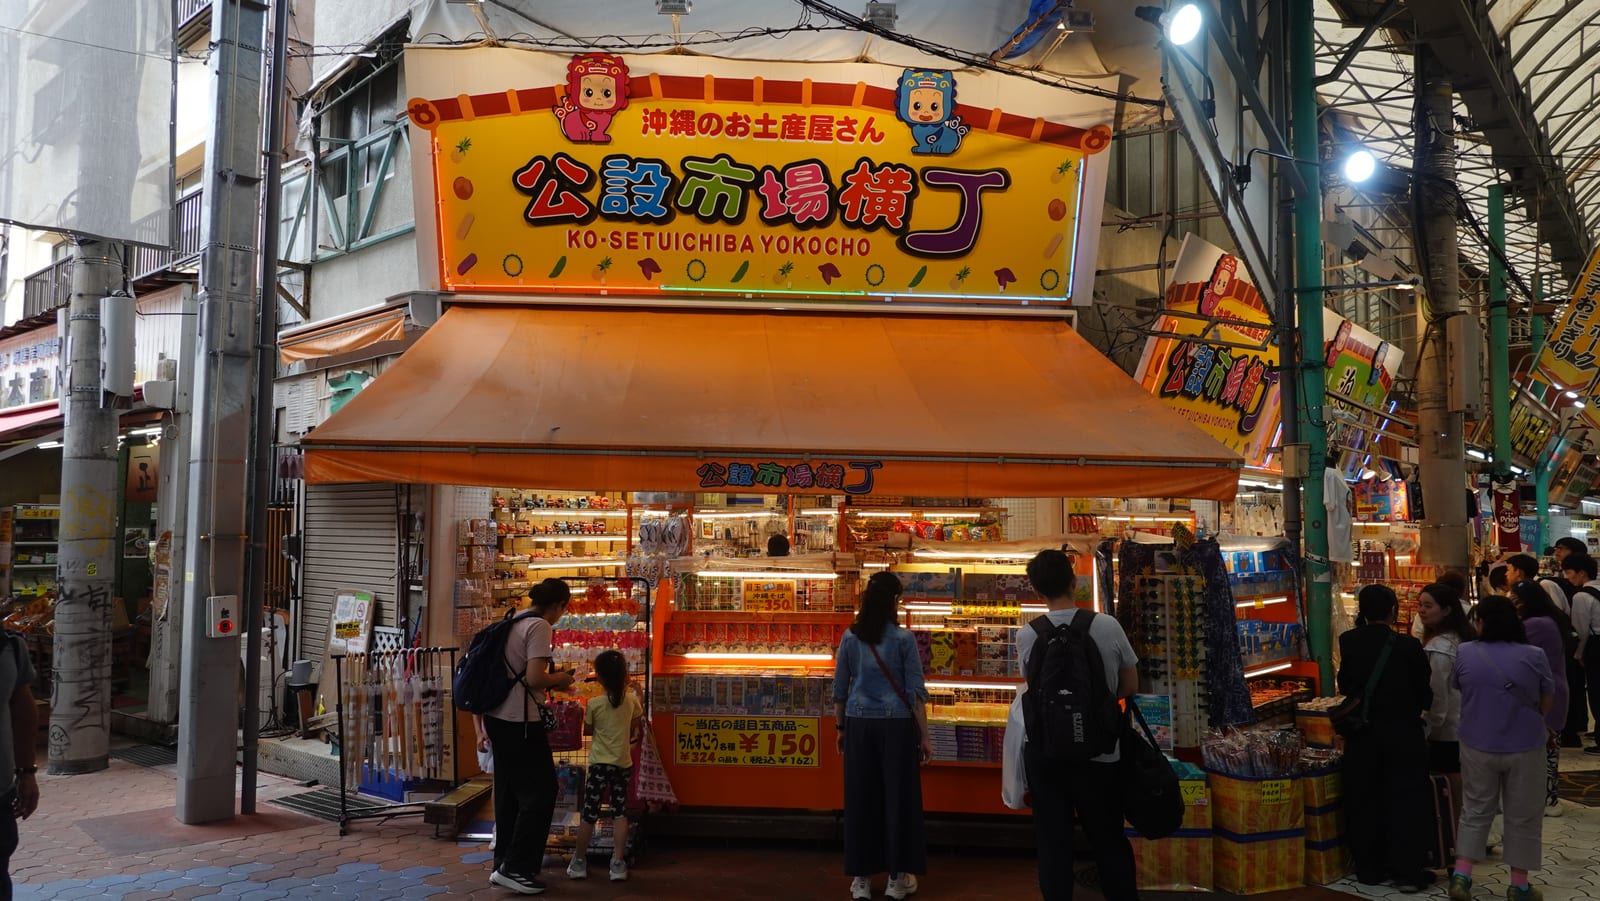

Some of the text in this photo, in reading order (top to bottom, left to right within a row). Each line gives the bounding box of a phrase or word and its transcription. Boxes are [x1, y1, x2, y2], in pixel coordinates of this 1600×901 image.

[642, 108, 885, 143] 沖縄のお土産屋さん
[513, 152, 1010, 258] 公設市場横丁
[567, 229, 871, 257] KO-SETUICHIBA YOKOCHO
[697, 461, 884, 494] 公設市場横丁
